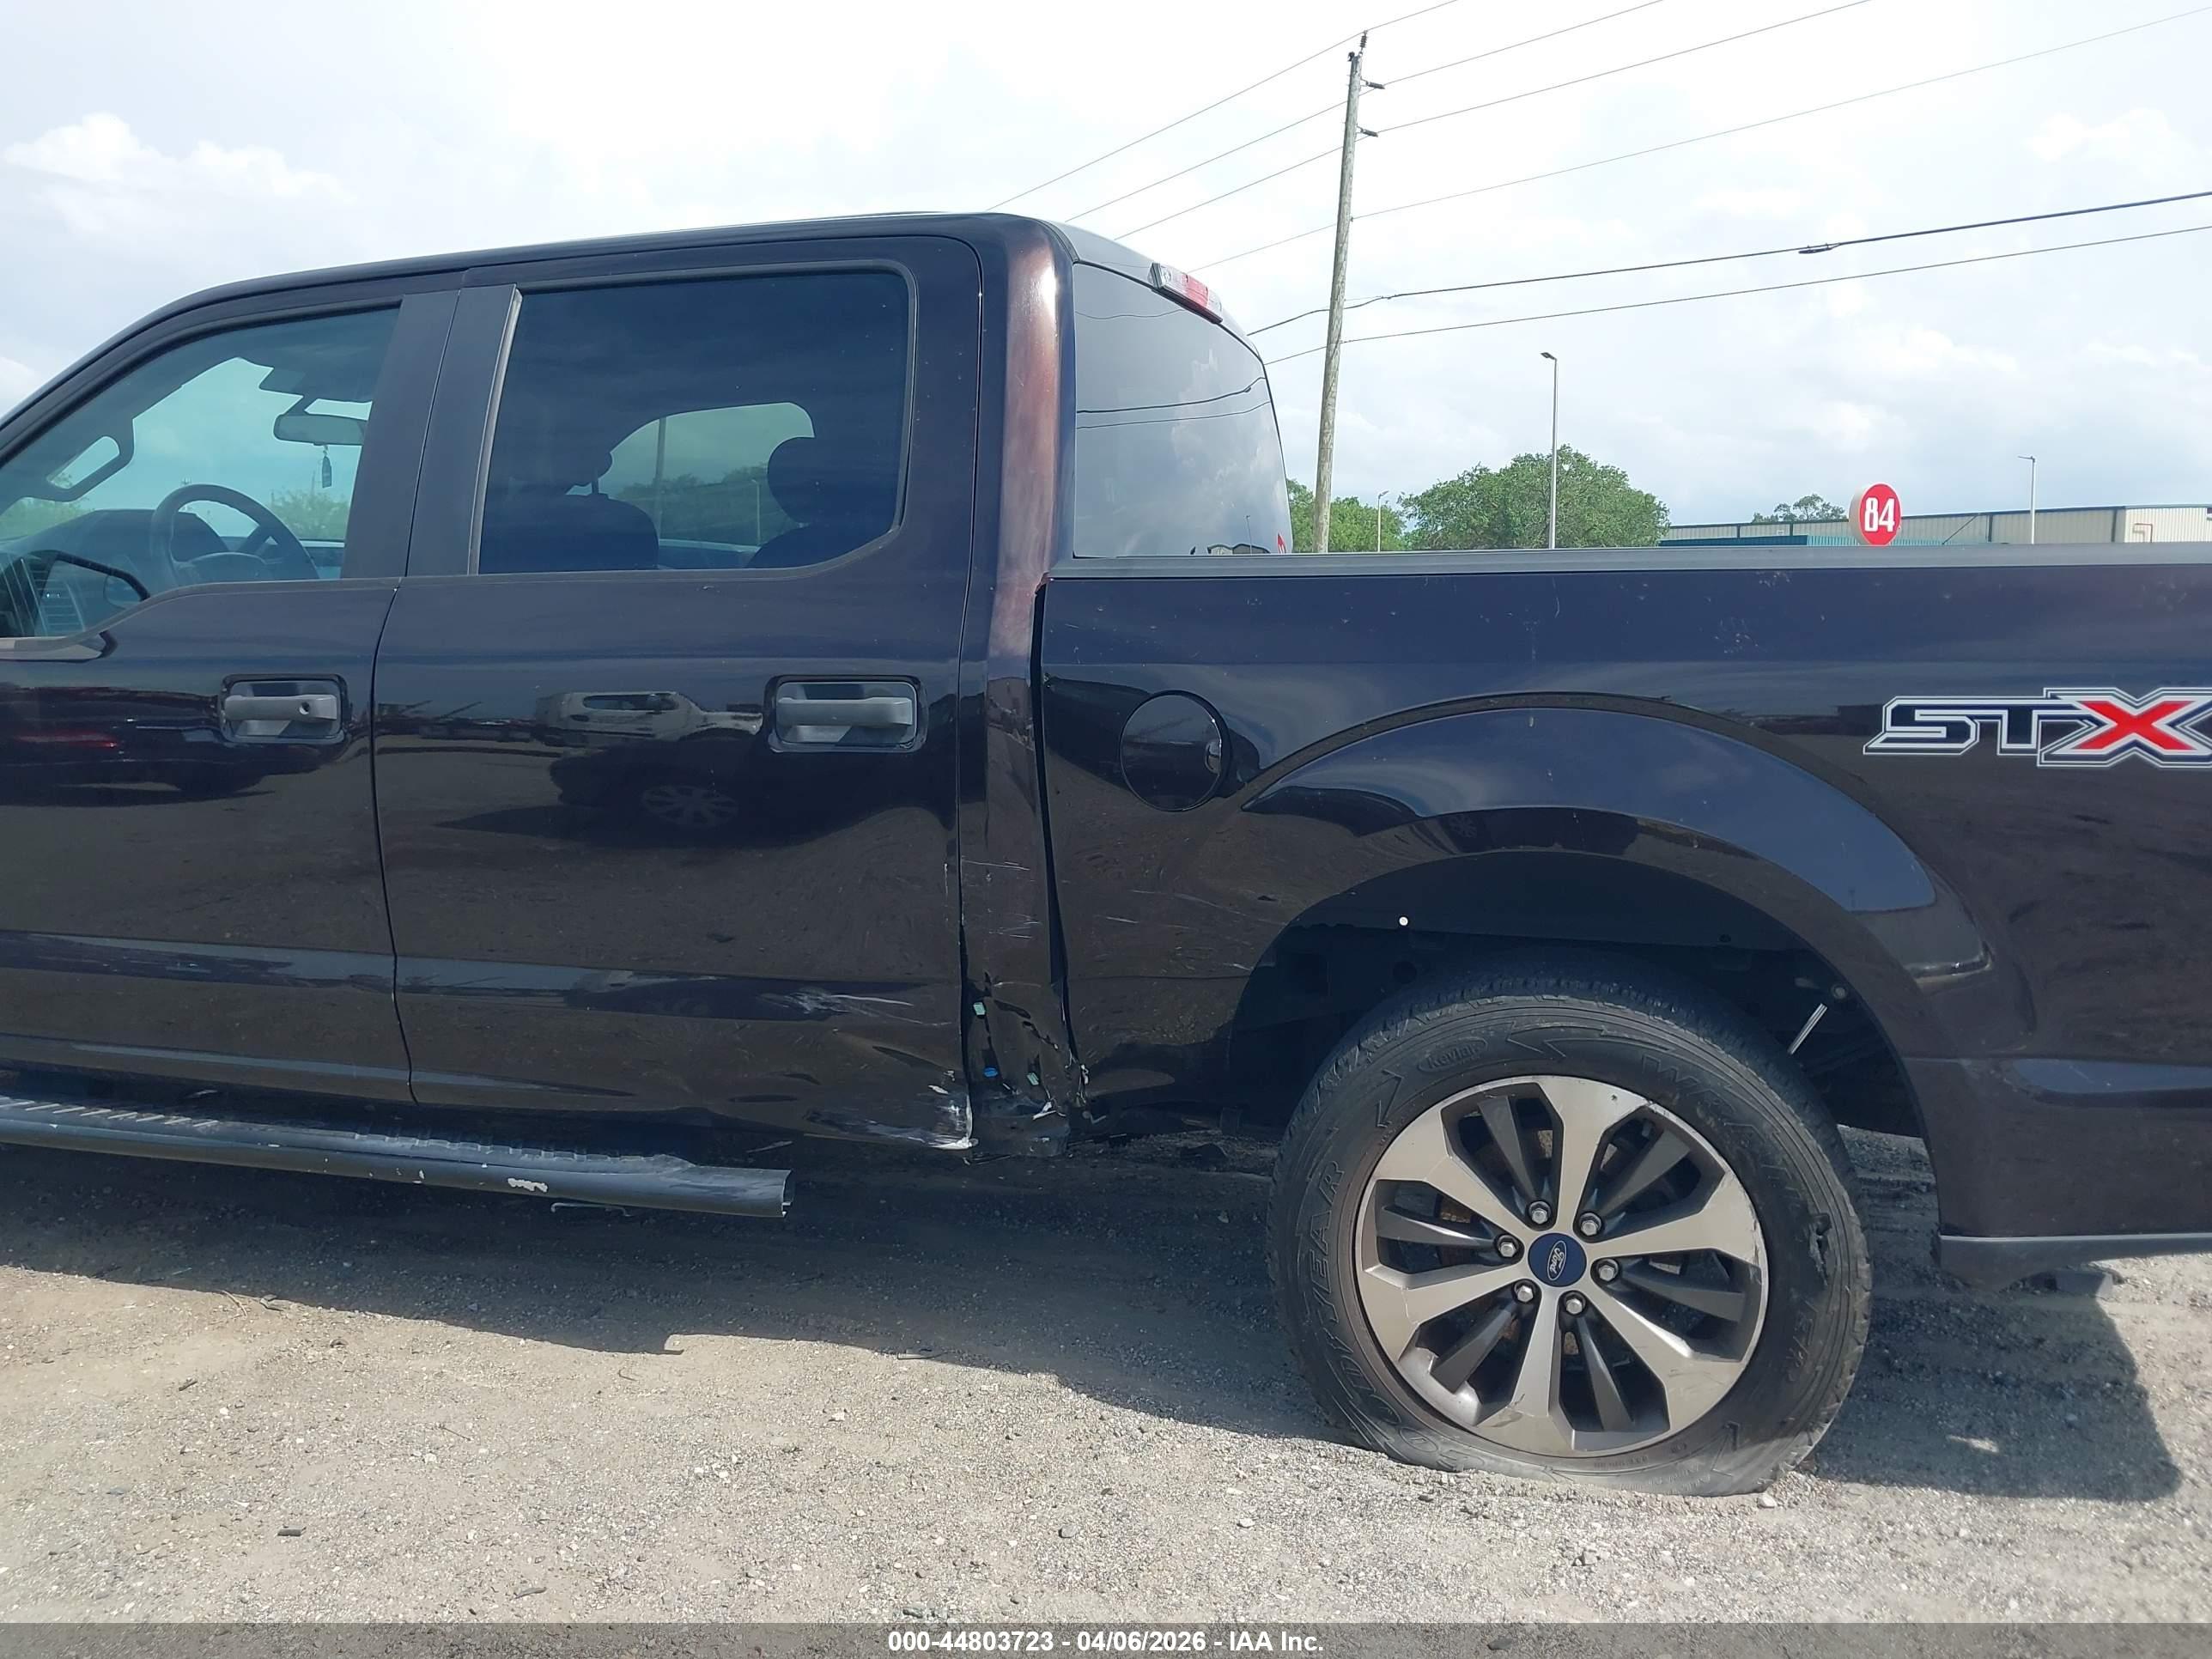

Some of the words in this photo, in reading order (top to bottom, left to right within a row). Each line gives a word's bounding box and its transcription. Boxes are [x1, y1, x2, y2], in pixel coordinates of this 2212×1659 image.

[1864, 497, 1895, 532] 84
[1863, 688, 2212, 768] STX
[1549, 1247, 1565, 1275] Ford
